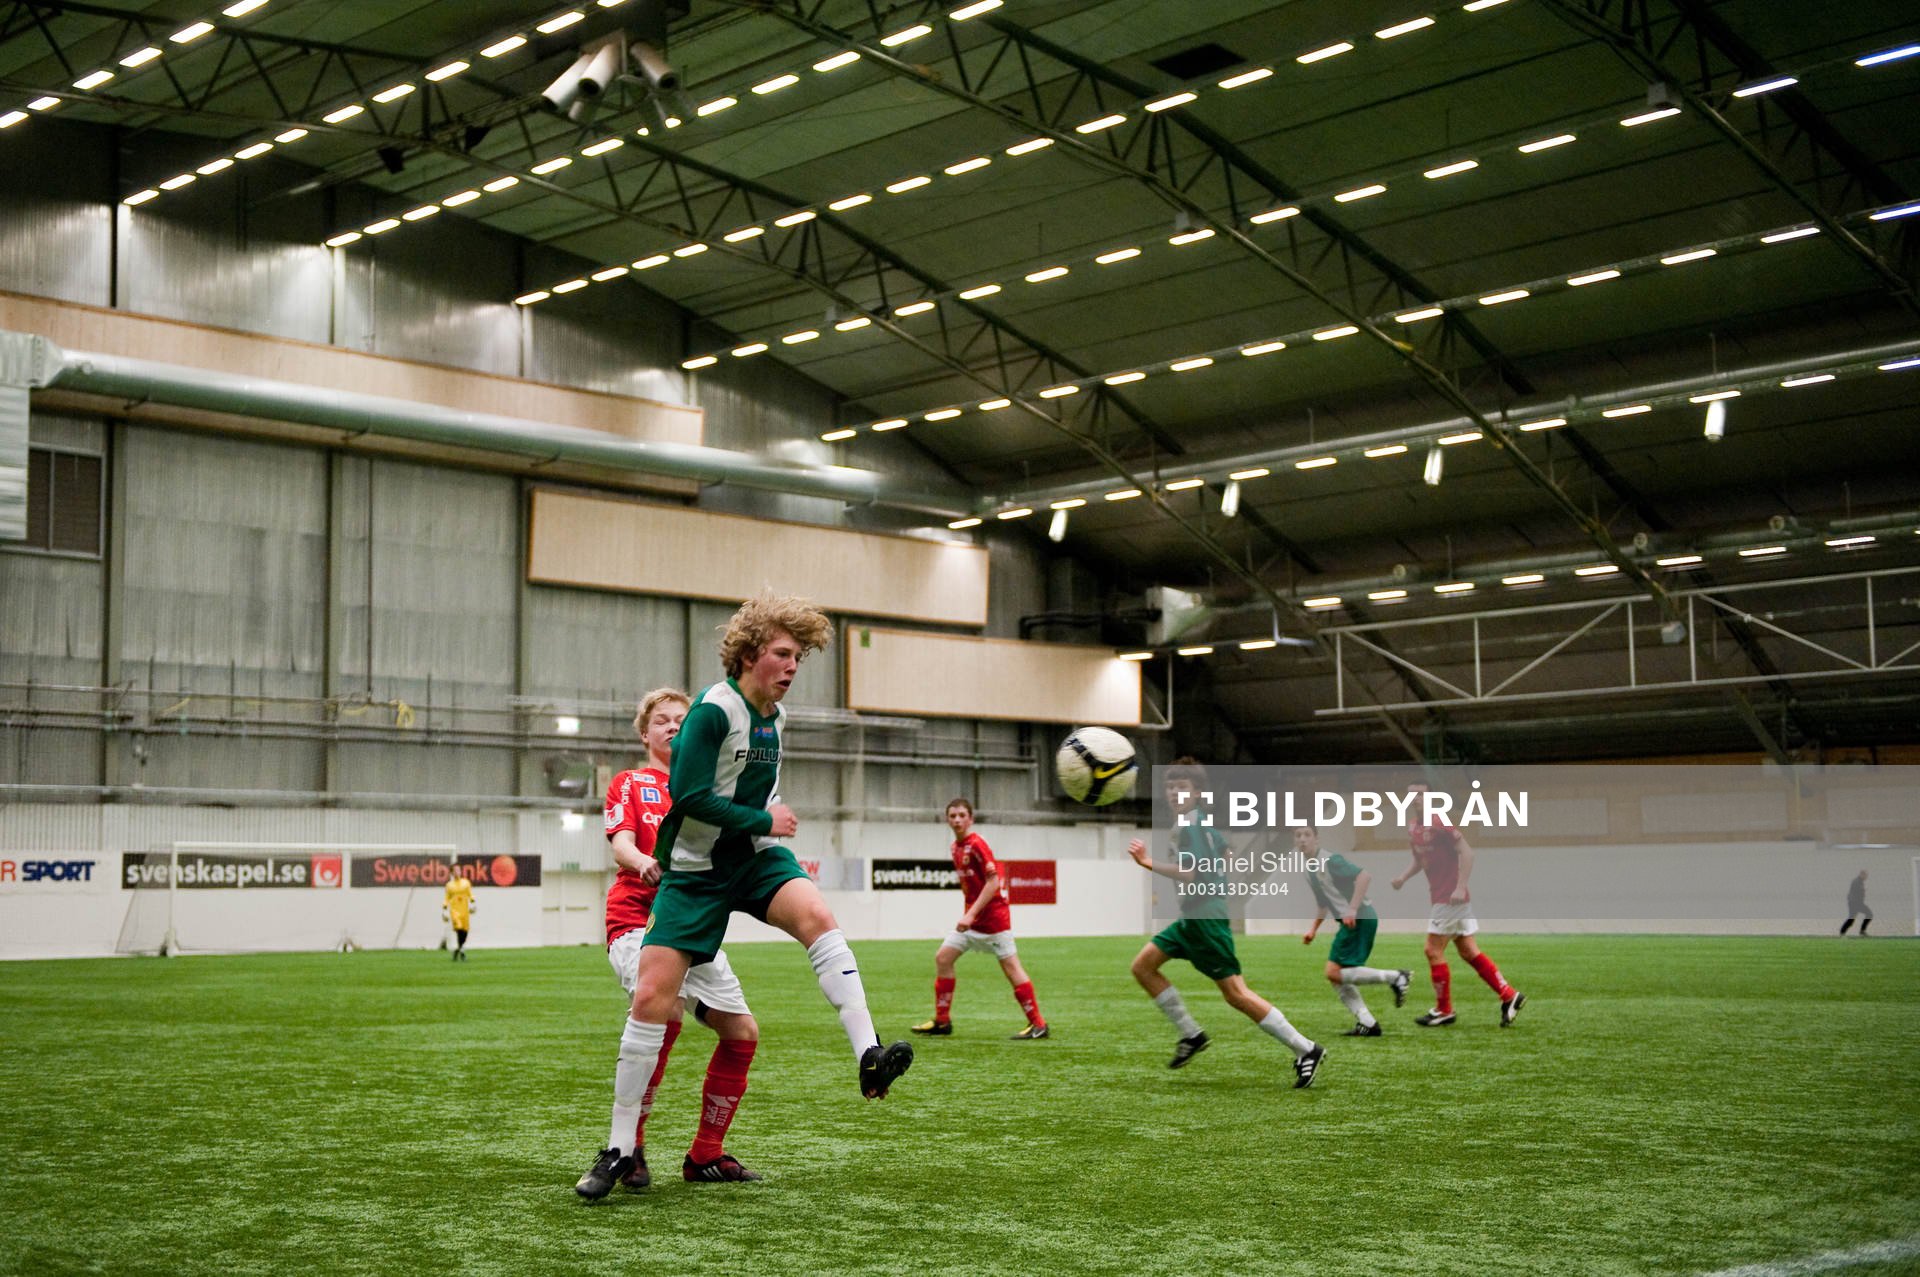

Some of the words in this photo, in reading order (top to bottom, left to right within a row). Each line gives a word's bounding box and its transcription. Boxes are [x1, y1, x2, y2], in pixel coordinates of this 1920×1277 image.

[734, 748, 782, 764] FINLU
[22, 861, 95, 882] SPORT
[127, 858, 306, 888] svenskaspel.se
[373, 858, 488, 883] Swedbnk
